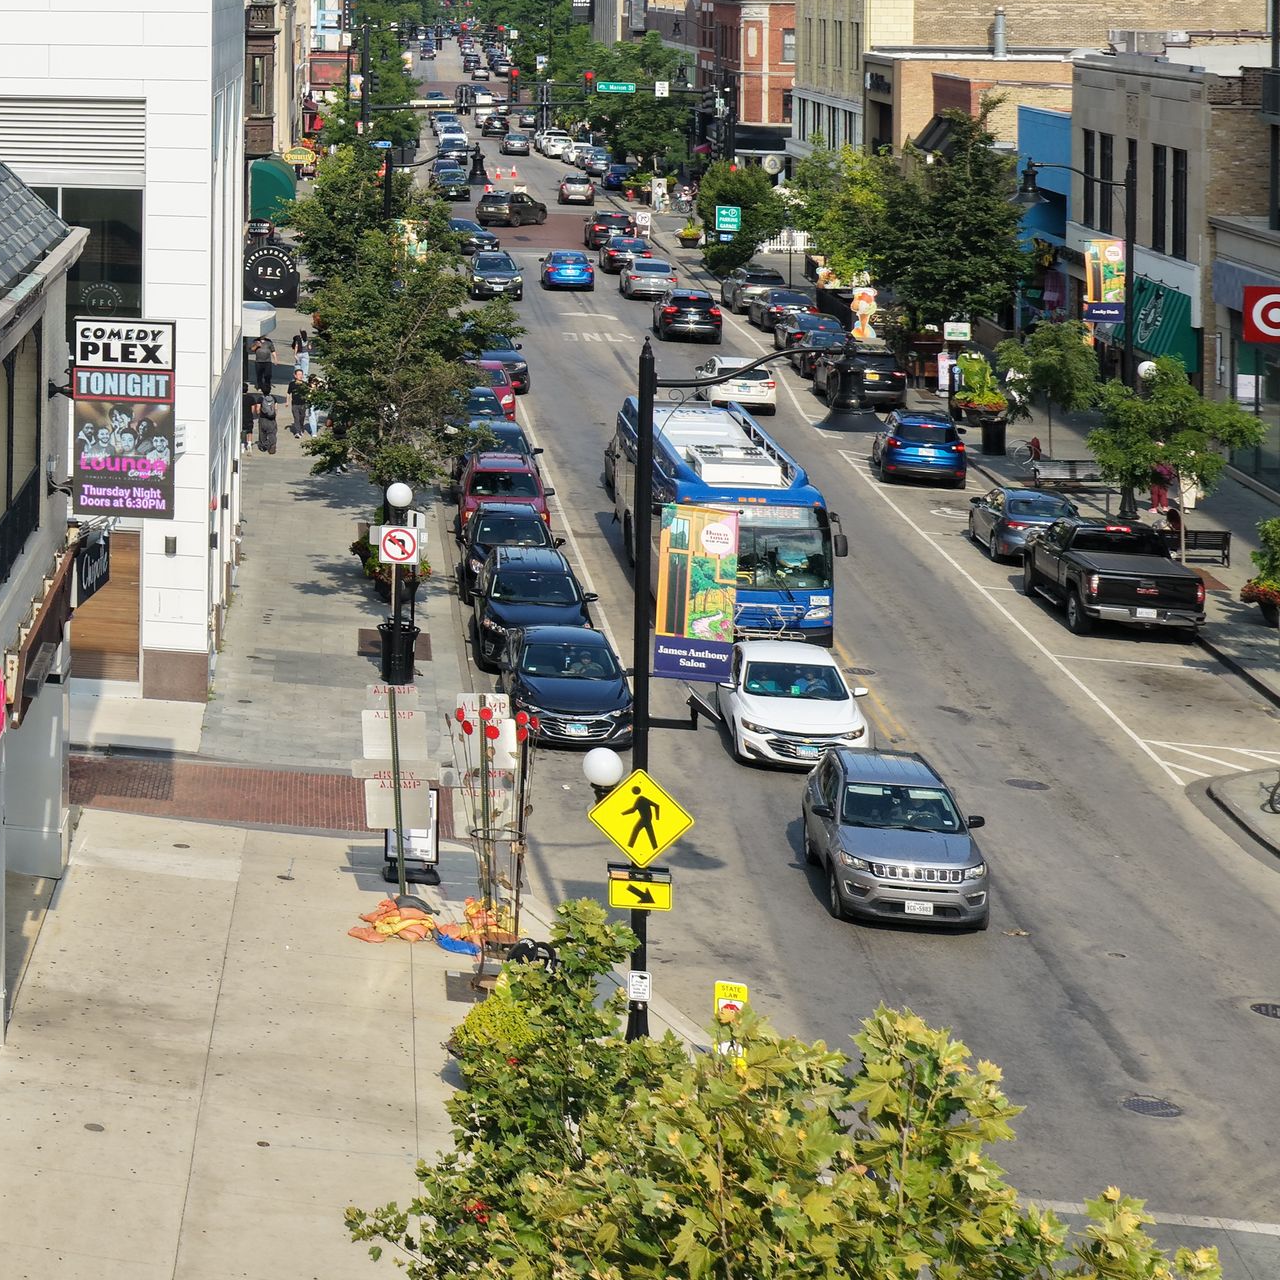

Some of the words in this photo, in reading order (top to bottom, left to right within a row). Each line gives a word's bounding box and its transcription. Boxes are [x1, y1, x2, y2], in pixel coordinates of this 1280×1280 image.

[245, 250, 267, 271] FITNESS
[269, 249, 295, 273] FORMULA
[253, 287, 284, 296] CLUBS
[80, 327, 164, 343] COMEDY
[80, 342, 164, 365] PLEX
[77, 371, 169, 398] TONIGHT
[82, 484, 131, 500] Thursday
[132, 487, 161, 501] Night
[80, 495, 111, 507] Doors
[112, 498, 124, 508] at
[125, 498, 166, 510] 6:30PM
[658, 645, 687, 656] James
[688, 648, 729, 663] Anthony
[679, 658, 706, 669] Salon
[721, 985, 742, 993] STATE
